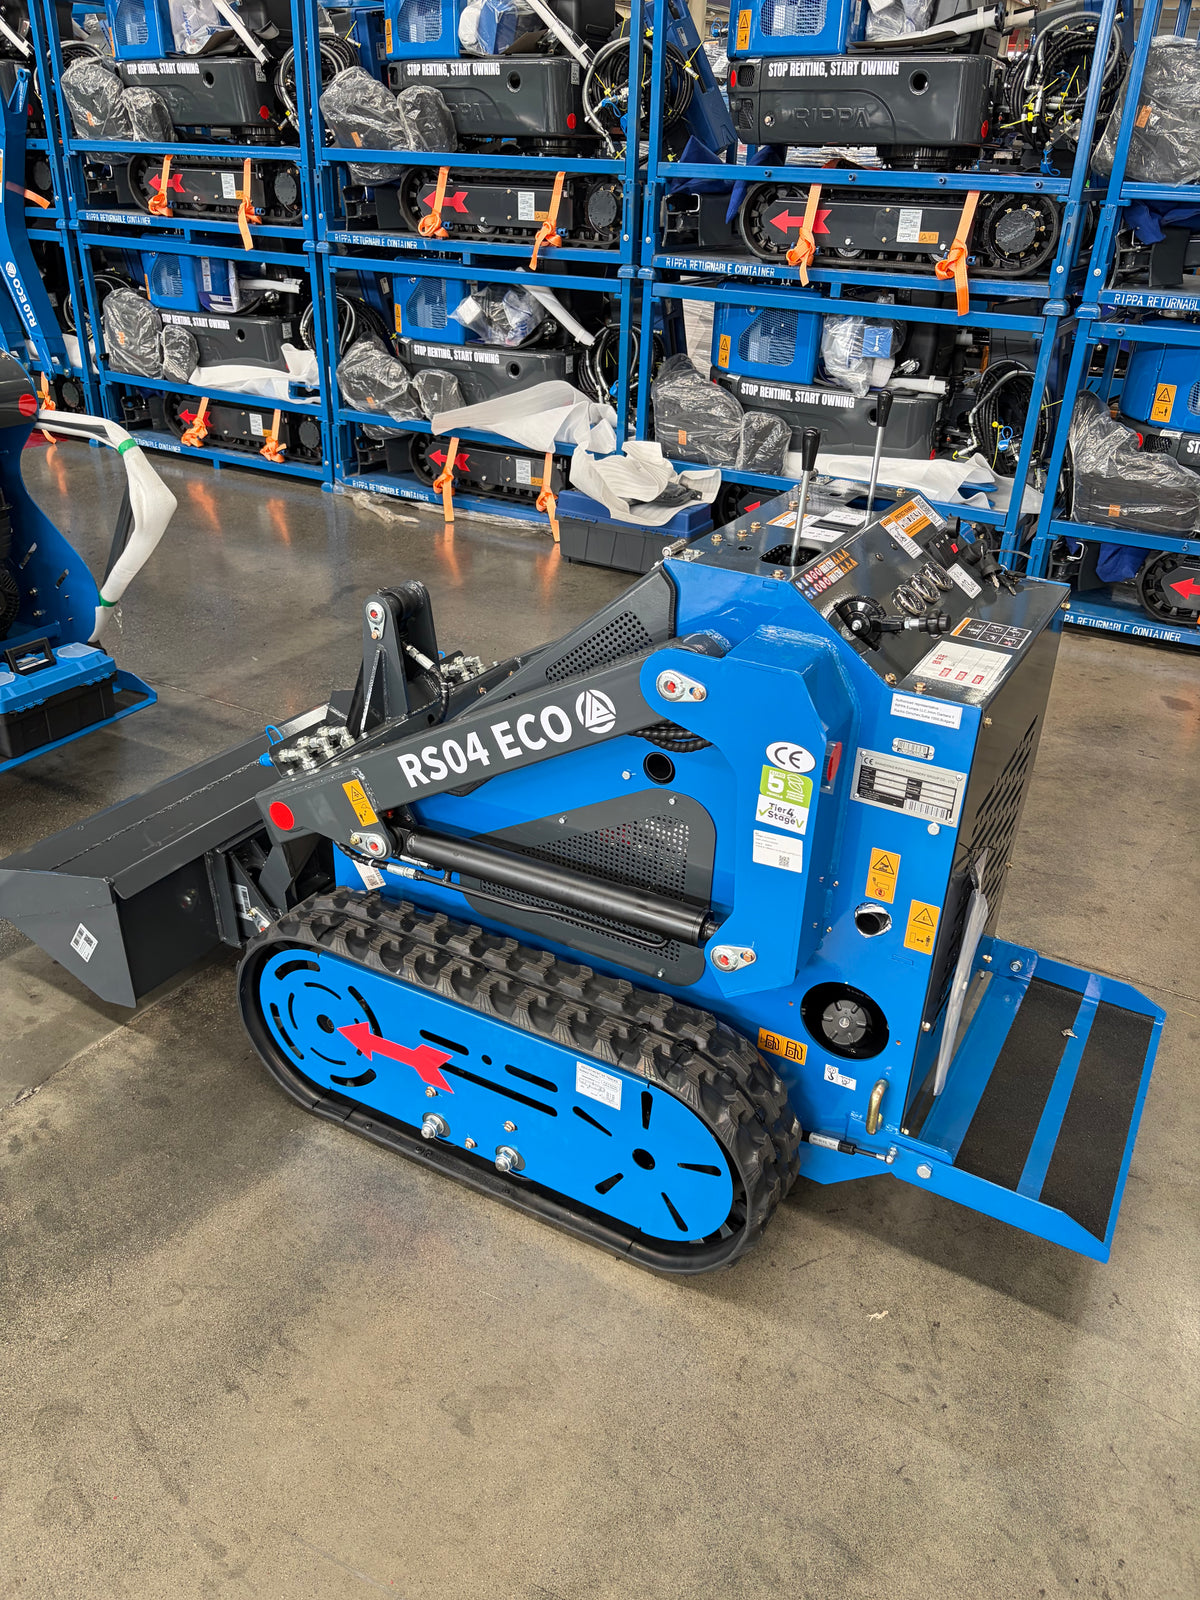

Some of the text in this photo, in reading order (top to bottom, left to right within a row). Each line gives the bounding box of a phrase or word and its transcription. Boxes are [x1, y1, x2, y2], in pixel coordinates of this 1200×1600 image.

[159, 62, 176, 75] START
[176, 62, 200, 75] OWNING
[407, 62, 500, 77] STOP RENTING, START OWNING
[768, 61, 900, 78] STOP RENTING, START OWNING
[793, 107, 871, 128] RIPPA
[386, 238, 418, 249] CONTAINER
[665, 257, 775, 277] RIPPA RETURNABLE CONTAINER
[12, 278, 37, 328] R10 ECO
[1114, 293, 1200, 311] RIPPA RETURNABL
[413, 344, 426, 356] STOP
[453, 349, 472, 362] START
[473, 351, 499, 365] OWNING
[741, 382, 855, 409] STOP RENTING, START OWNING
[1077, 616, 1130, 633] RETURNABLE
[1131, 625, 1182, 643] CONTAINER
[397, 705, 573, 788] RS04 ECO
[774, 746, 803, 770] CE
[863, 757, 874, 766] CE
[767, 770, 785, 794] 5
[767, 810, 796, 825] Stage
[768, 802, 787, 814] Tier
